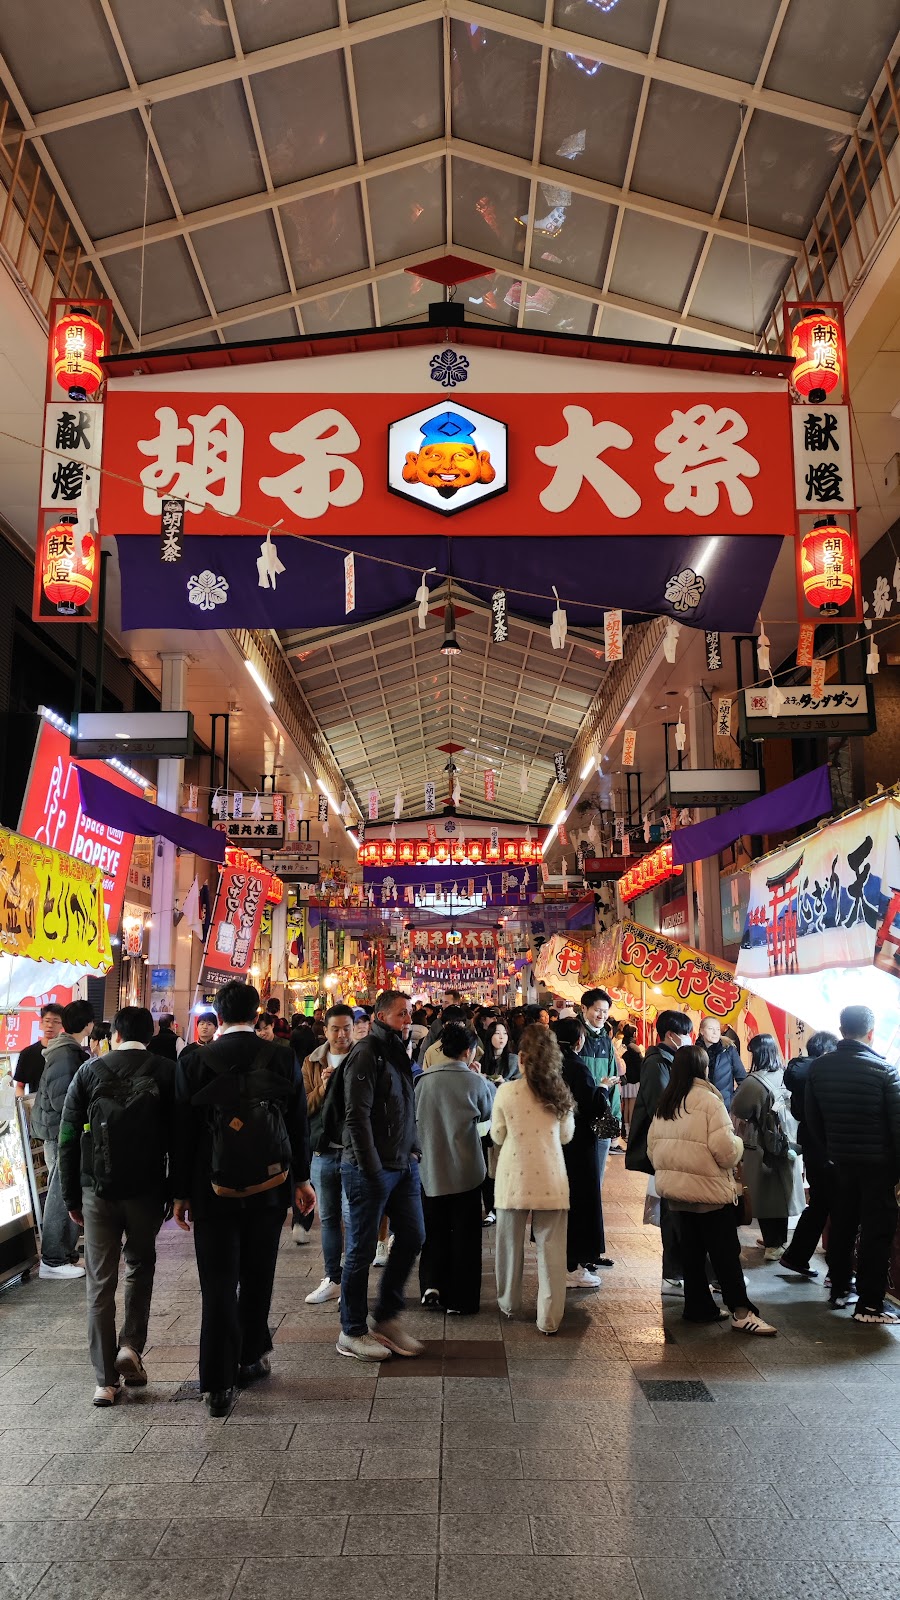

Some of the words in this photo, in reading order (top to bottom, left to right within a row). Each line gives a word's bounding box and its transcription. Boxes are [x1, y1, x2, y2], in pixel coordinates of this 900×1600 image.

[65, 325, 85, 374] 胡子神社
[811, 323, 838, 372] 献燈
[51, 410, 92, 502] 献燈
[137, 404, 365, 519] 胡子
[534, 403, 760, 519] 大祭
[802, 412, 845, 503] 献燈
[47, 535, 74, 584] 献燈
[161, 511, 183, 562] 胡子大祭
[823, 538, 844, 589] 胡子神社
[493, 597, 508, 642] 胡子大祭
[606, 619, 622, 660] 胡子大祭
[706, 631, 722, 670] 胡子大祭
[798, 630, 813, 666] 胡子大祭
[812, 667, 824, 698] 胡子大祭
[719, 705, 730, 735] 胡子大祭
[624, 736, 635, 765] 胡子大祭
[228, 823, 278, 836] 磯丸水産
[74, 834, 121, 876] POPEYE
[621, 932, 741, 1017] いかやき
